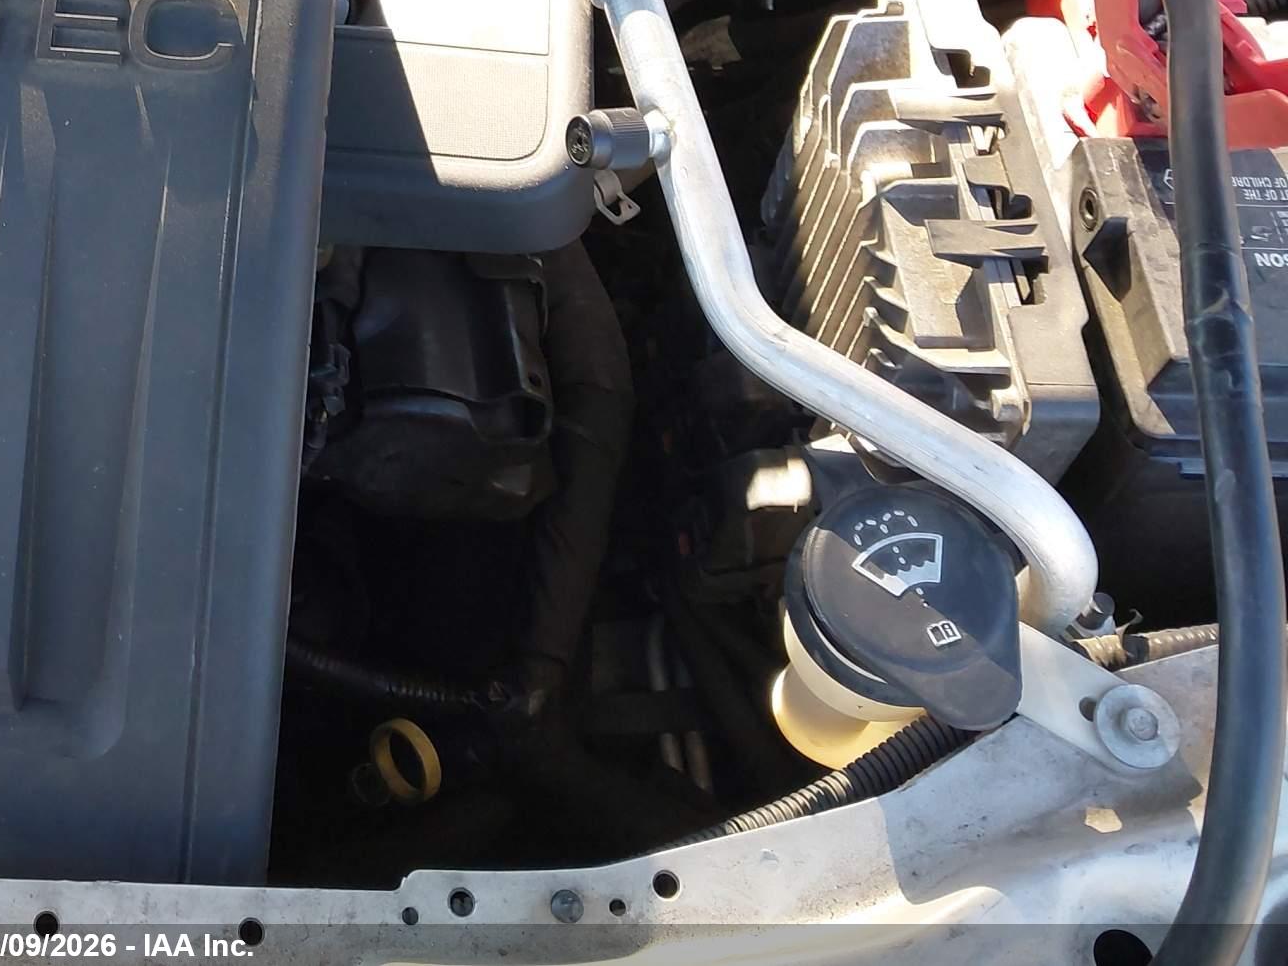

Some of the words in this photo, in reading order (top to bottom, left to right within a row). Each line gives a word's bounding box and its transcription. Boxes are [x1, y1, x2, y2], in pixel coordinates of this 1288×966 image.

[1273, 177, 1288, 188] OF
[1243, 188, 1263, 201] THE
[1265, 189, 1279, 201] OF
